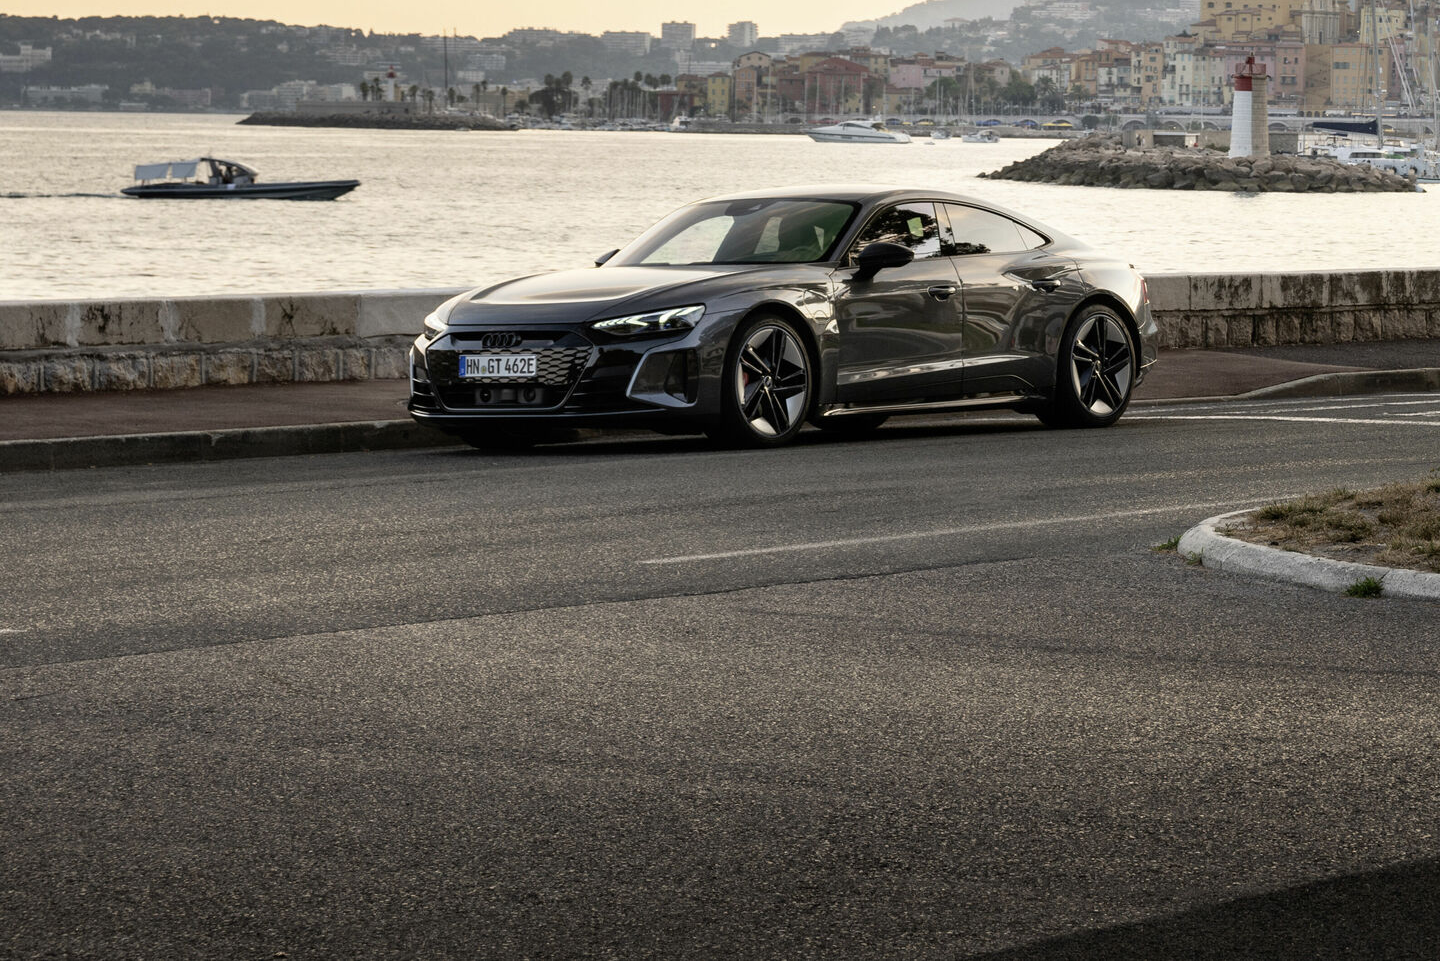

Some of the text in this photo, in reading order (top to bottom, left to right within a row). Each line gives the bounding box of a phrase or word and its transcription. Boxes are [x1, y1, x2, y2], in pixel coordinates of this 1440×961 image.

[466, 358, 535, 374] HN GT 462E
